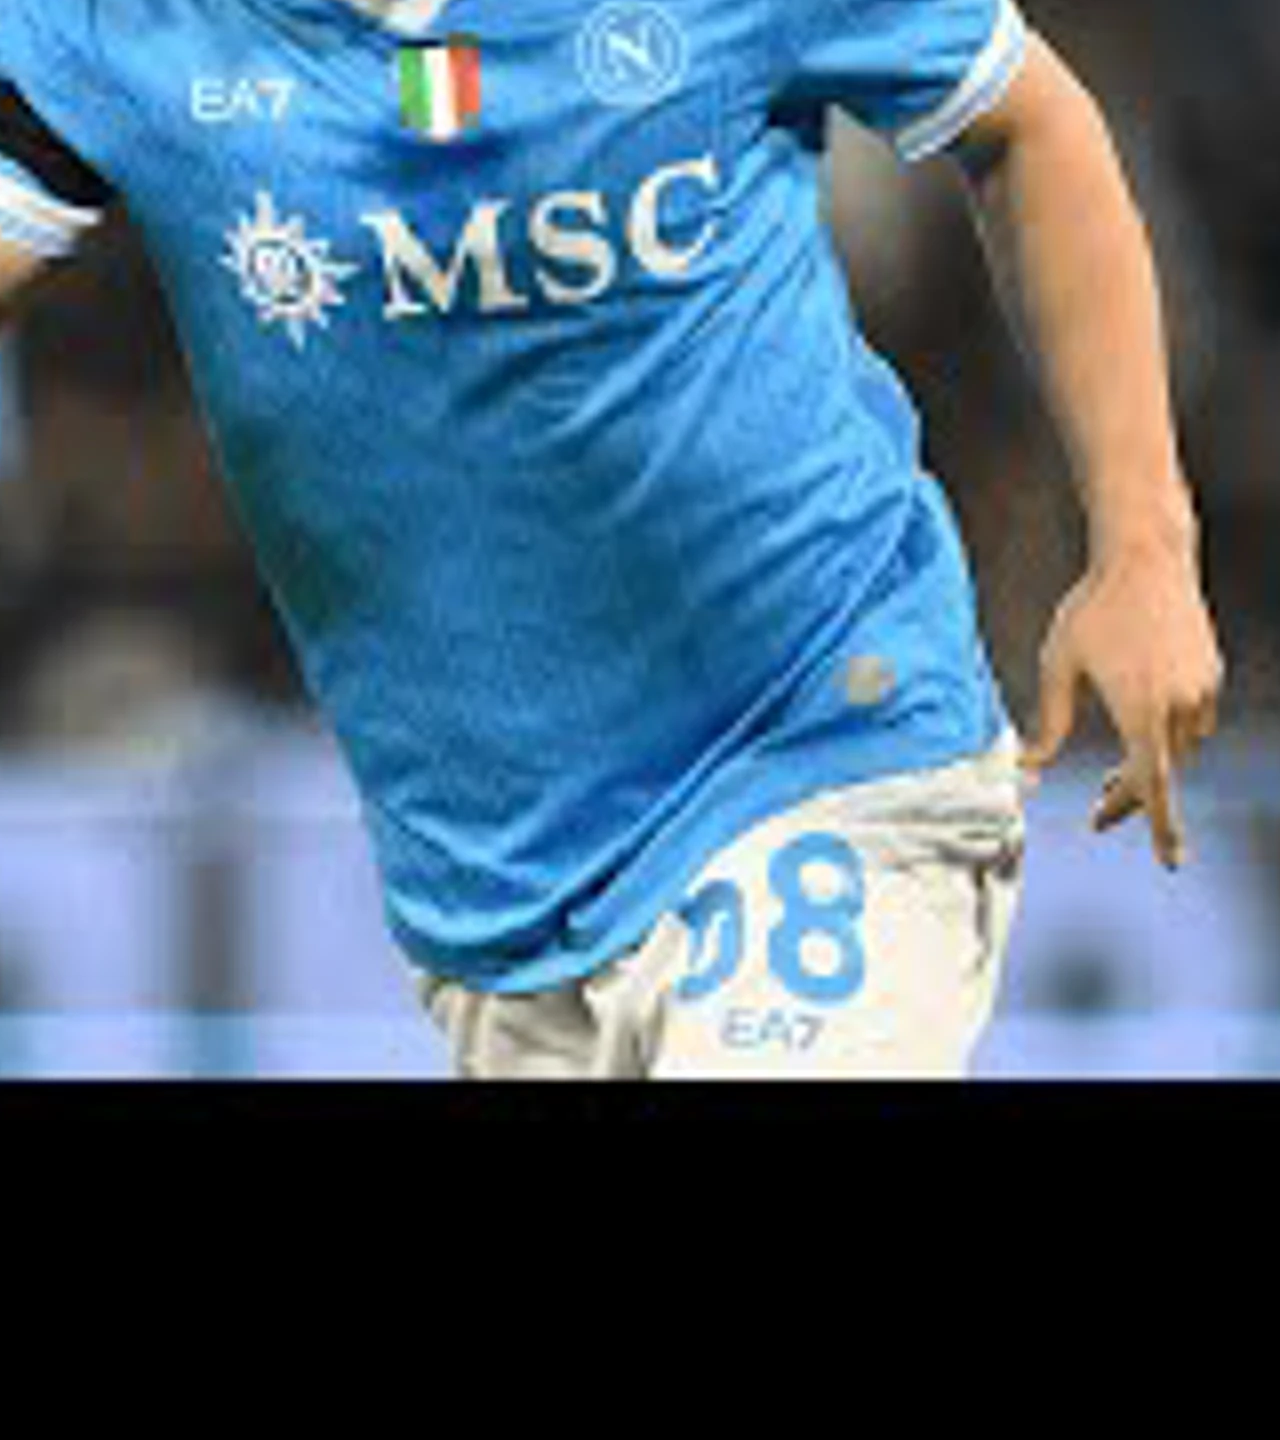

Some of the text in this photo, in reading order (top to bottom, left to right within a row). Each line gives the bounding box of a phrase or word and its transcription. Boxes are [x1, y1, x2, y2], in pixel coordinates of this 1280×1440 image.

[189, 77, 298, 123] EA7
[360, 150, 723, 322] MSC
[722, 1007, 825, 1050] EA7
